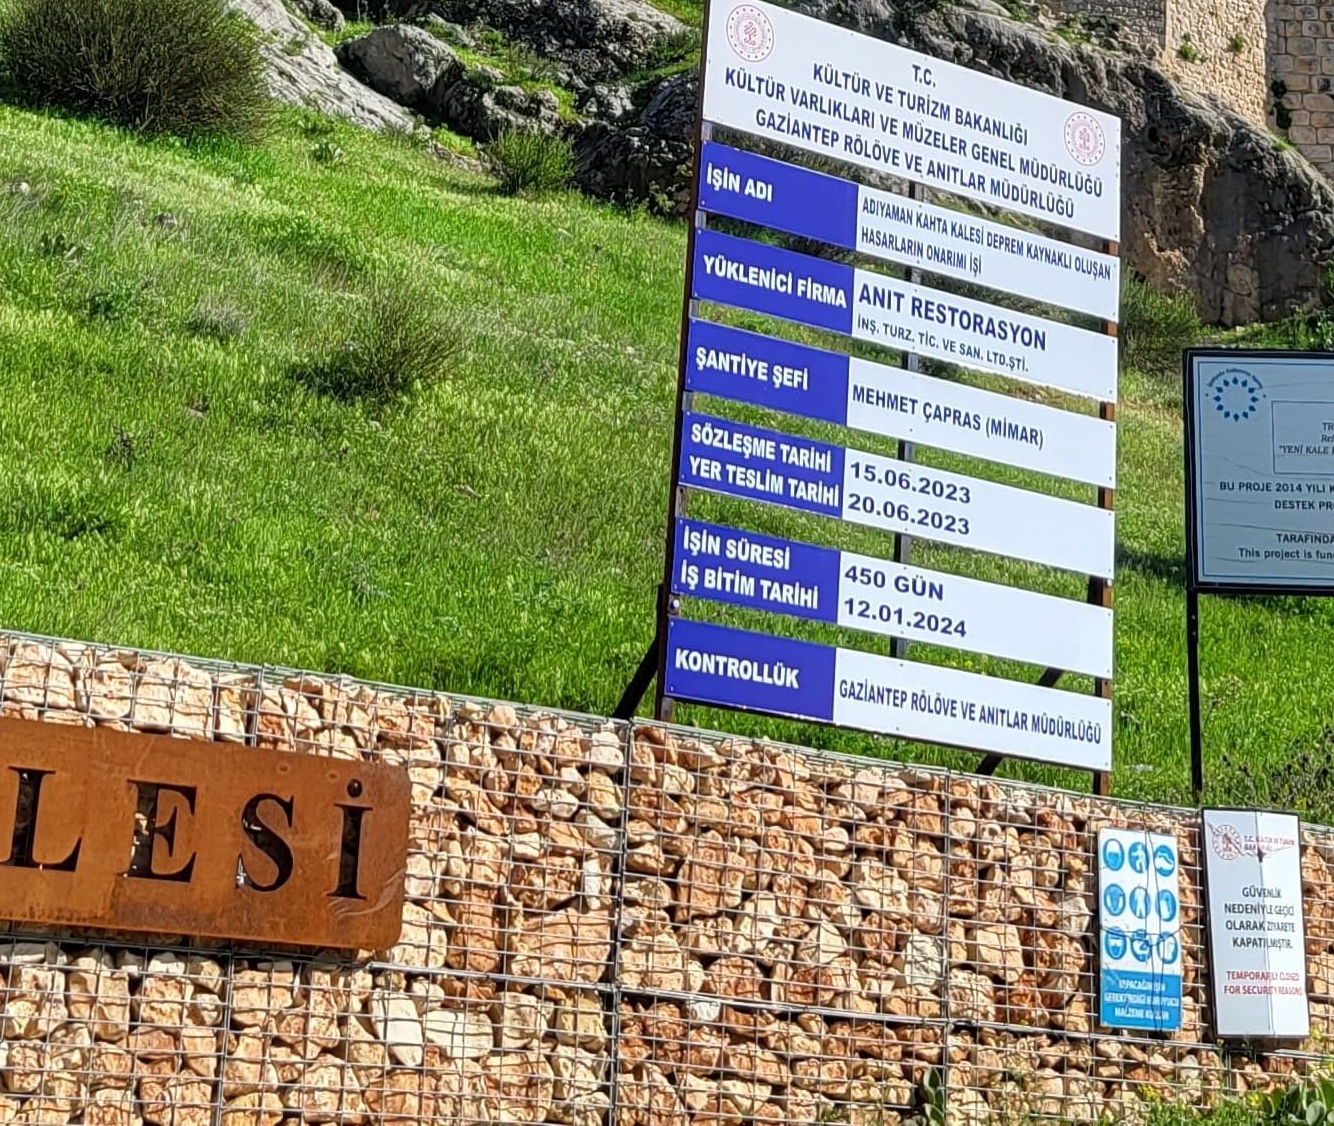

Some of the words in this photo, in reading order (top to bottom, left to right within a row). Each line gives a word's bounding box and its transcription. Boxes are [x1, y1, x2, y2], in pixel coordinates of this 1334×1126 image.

[912, 63, 936, 88] T.C.
[813, 62, 871, 95] KÜLTÜR
[875, 83, 893, 105] VE
[898, 89, 951, 122] TURİZM
[955, 107, 1028, 146] BAKANLIĞI
[725, 67, 785, 101] KÜLTÜR
[791, 86, 875, 125] VARLIKLARI
[880, 113, 898, 135] VE
[902, 120, 968, 156] MÜZELER
[971, 143, 1016, 173] GENEL
[1019, 155, 1103, 197] MÜDÜRLÜĞÜ
[706, 162, 741, 195] İŞİN
[744, 179, 773, 201] ADI
[756, 108, 840, 149] GAZİANTEP
[844, 133, 900, 167] RÖLÖVE
[905, 154, 923, 174] VE
[926, 161, 986, 193] ANITLAR
[990, 178, 1075, 218] MÜDÜRLÜĞÜ
[861, 230, 924, 262] HASARLARIN
[926, 245, 967, 269] ONARIMI
[969, 252, 982, 275] İŞİ
[862, 196, 913, 223] ADIYAMAN
[916, 213, 949, 236] KAHTA
[951, 219, 984, 245] KALESİ
[986, 230, 1024, 255] DEPREM
[1027, 242, 1072, 269] KAYNAKLI
[1074, 254, 1111, 281] OLUŞAN
[703, 255, 793, 295] YÜKLENİCİ
[797, 275, 847, 308] FİRMA
[858, 283, 906, 314] ANIT
[911, 296, 1047, 351] RESTORASYON
[857, 315, 880, 336] İNŞ.
[883, 323, 915, 344] TURZ.
[918, 329, 939, 349] TİC.
[942, 338, 956, 354] VE
[958, 341, 983, 362] SAN.
[986, 347, 1029, 372] LTD.ŞTİ.
[695, 347, 768, 383] ŞANTİYE
[772, 365, 809, 390] ŞEFİ
[852, 385, 918, 416] MEHMET
[922, 403, 982, 434] ÇAPRAS
[985, 414, 1044, 450] (MİMAR)
[691, 422, 776, 460] SÖZLEŞME
[780, 442, 831, 473] TARİHİ
[1305, 446, 1328, 454] KALE
[689, 455, 720, 480] YER
[725, 461, 784, 494] TESLİM
[788, 476, 840, 507] TARİHİ
[851, 461, 971, 504] 15.06.2023
[1220, 482, 1235, 492] BU
[1239, 482, 1272, 493] PROJE
[1276, 483, 1302, 493] 2014
[1306, 484, 1325, 493] YILI
[848, 494, 970, 536] 20.06.2023
[1274, 500, 1315, 510] DESTEK
[683, 525, 721, 556] İŞİN
[726, 537, 791, 570] SÜRESİ
[1239, 548, 1260, 559] This
[1264, 549, 1300, 561] project
[1304, 550, 1312, 560] is
[681, 559, 699, 586] İŞ
[704, 565, 756, 598] BİTİM
[759, 579, 818, 610] TARİHİ
[845, 565, 886, 590] 450
[894, 573, 944, 601] GÜN
[845, 597, 967, 637] 12.01.2024
[676, 647, 799, 689] KONTROLLÜK
[839, 676, 908, 709] GAZİANTEP
[911, 691, 958, 719] RÖLÖVE
[961, 701, 976, 720] VE
[979, 705, 1028, 730] ANITLAR
[1031, 714, 1102, 744] MÜDÜRLÜĞÜ
[1242, 885, 1281, 898] GÜVENLİK
[1226, 920, 1265, 931] OLARAK
[1224, 986, 1240, 994] FOR
